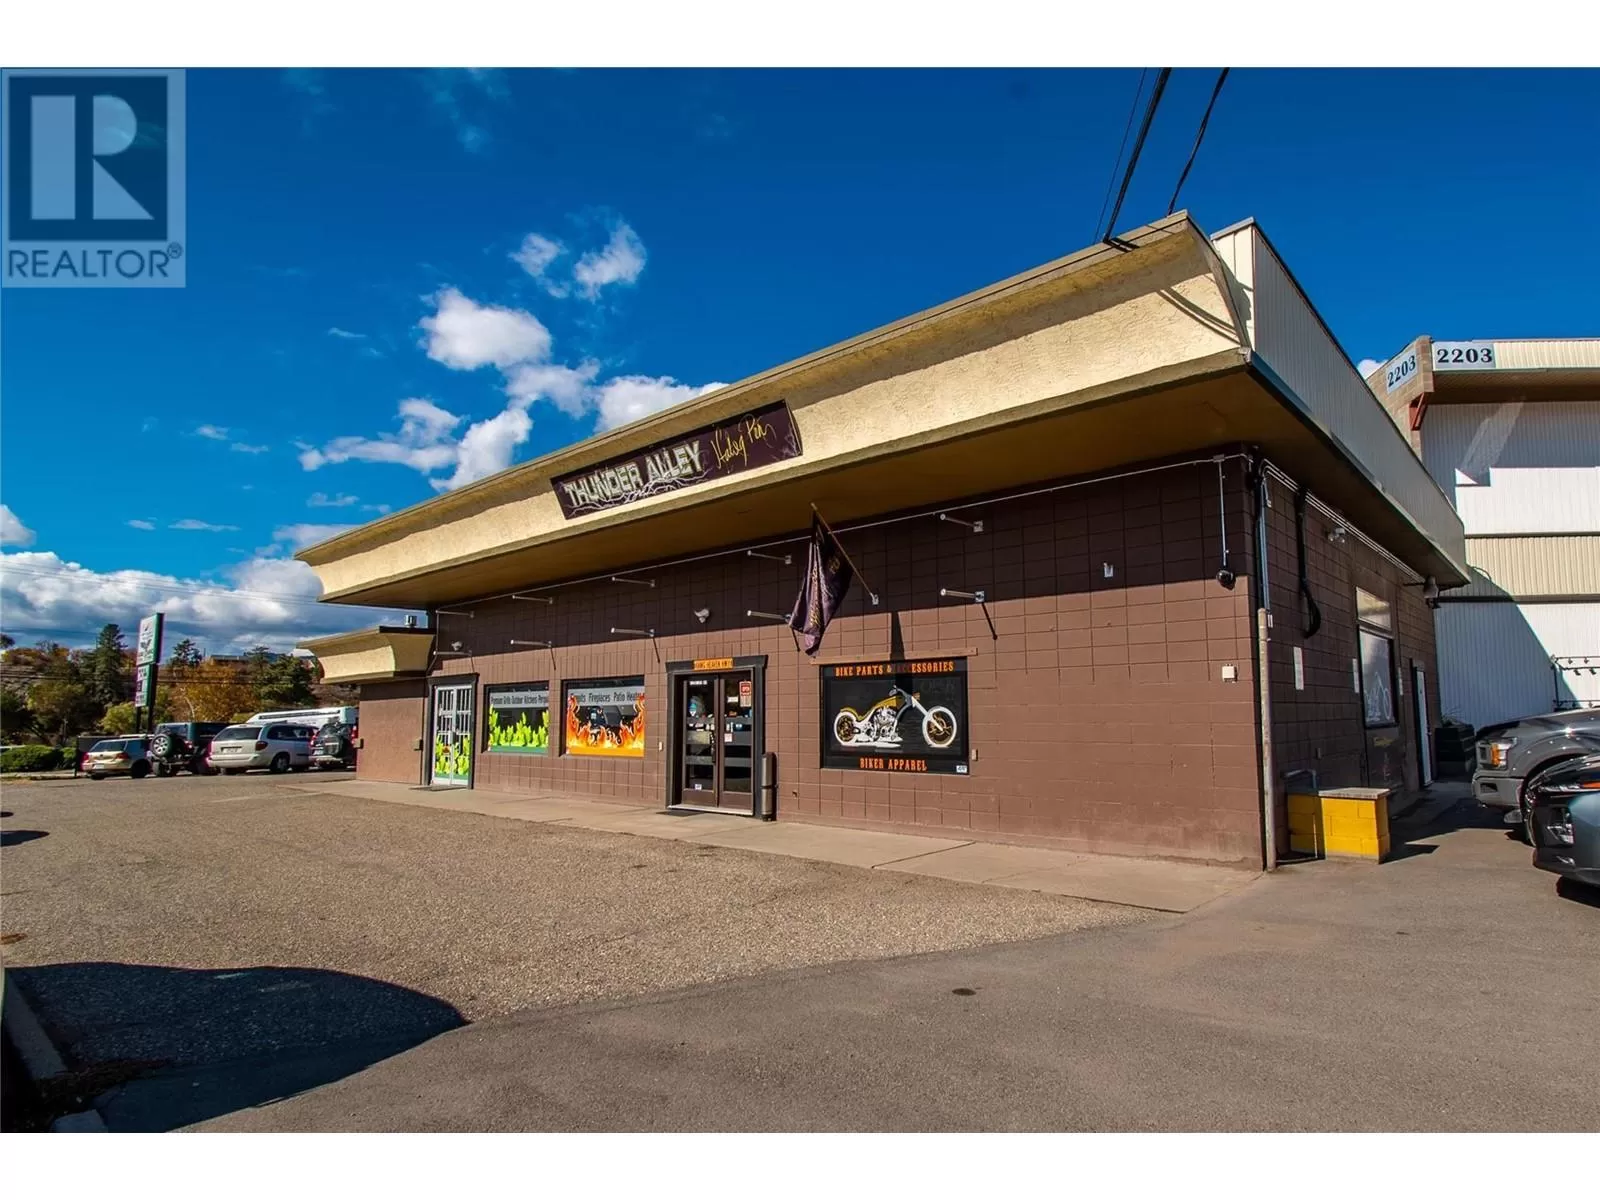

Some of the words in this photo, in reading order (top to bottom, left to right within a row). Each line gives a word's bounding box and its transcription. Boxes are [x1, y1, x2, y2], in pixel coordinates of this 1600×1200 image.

[1436, 348, 1493, 364] 2203
[1387, 355, 1417, 388] 2203
[564, 461, 644, 507] THUNDER
[645, 440, 703, 481] ALLEY
[835, 666, 853, 677] BIKE
[856, 664, 883, 676] PARTS
[886, 664, 892, 674] &
[613, 691, 625, 702] Patio
[859, 757, 884, 769] BIKER
[887, 758, 927, 772] APPAREL
